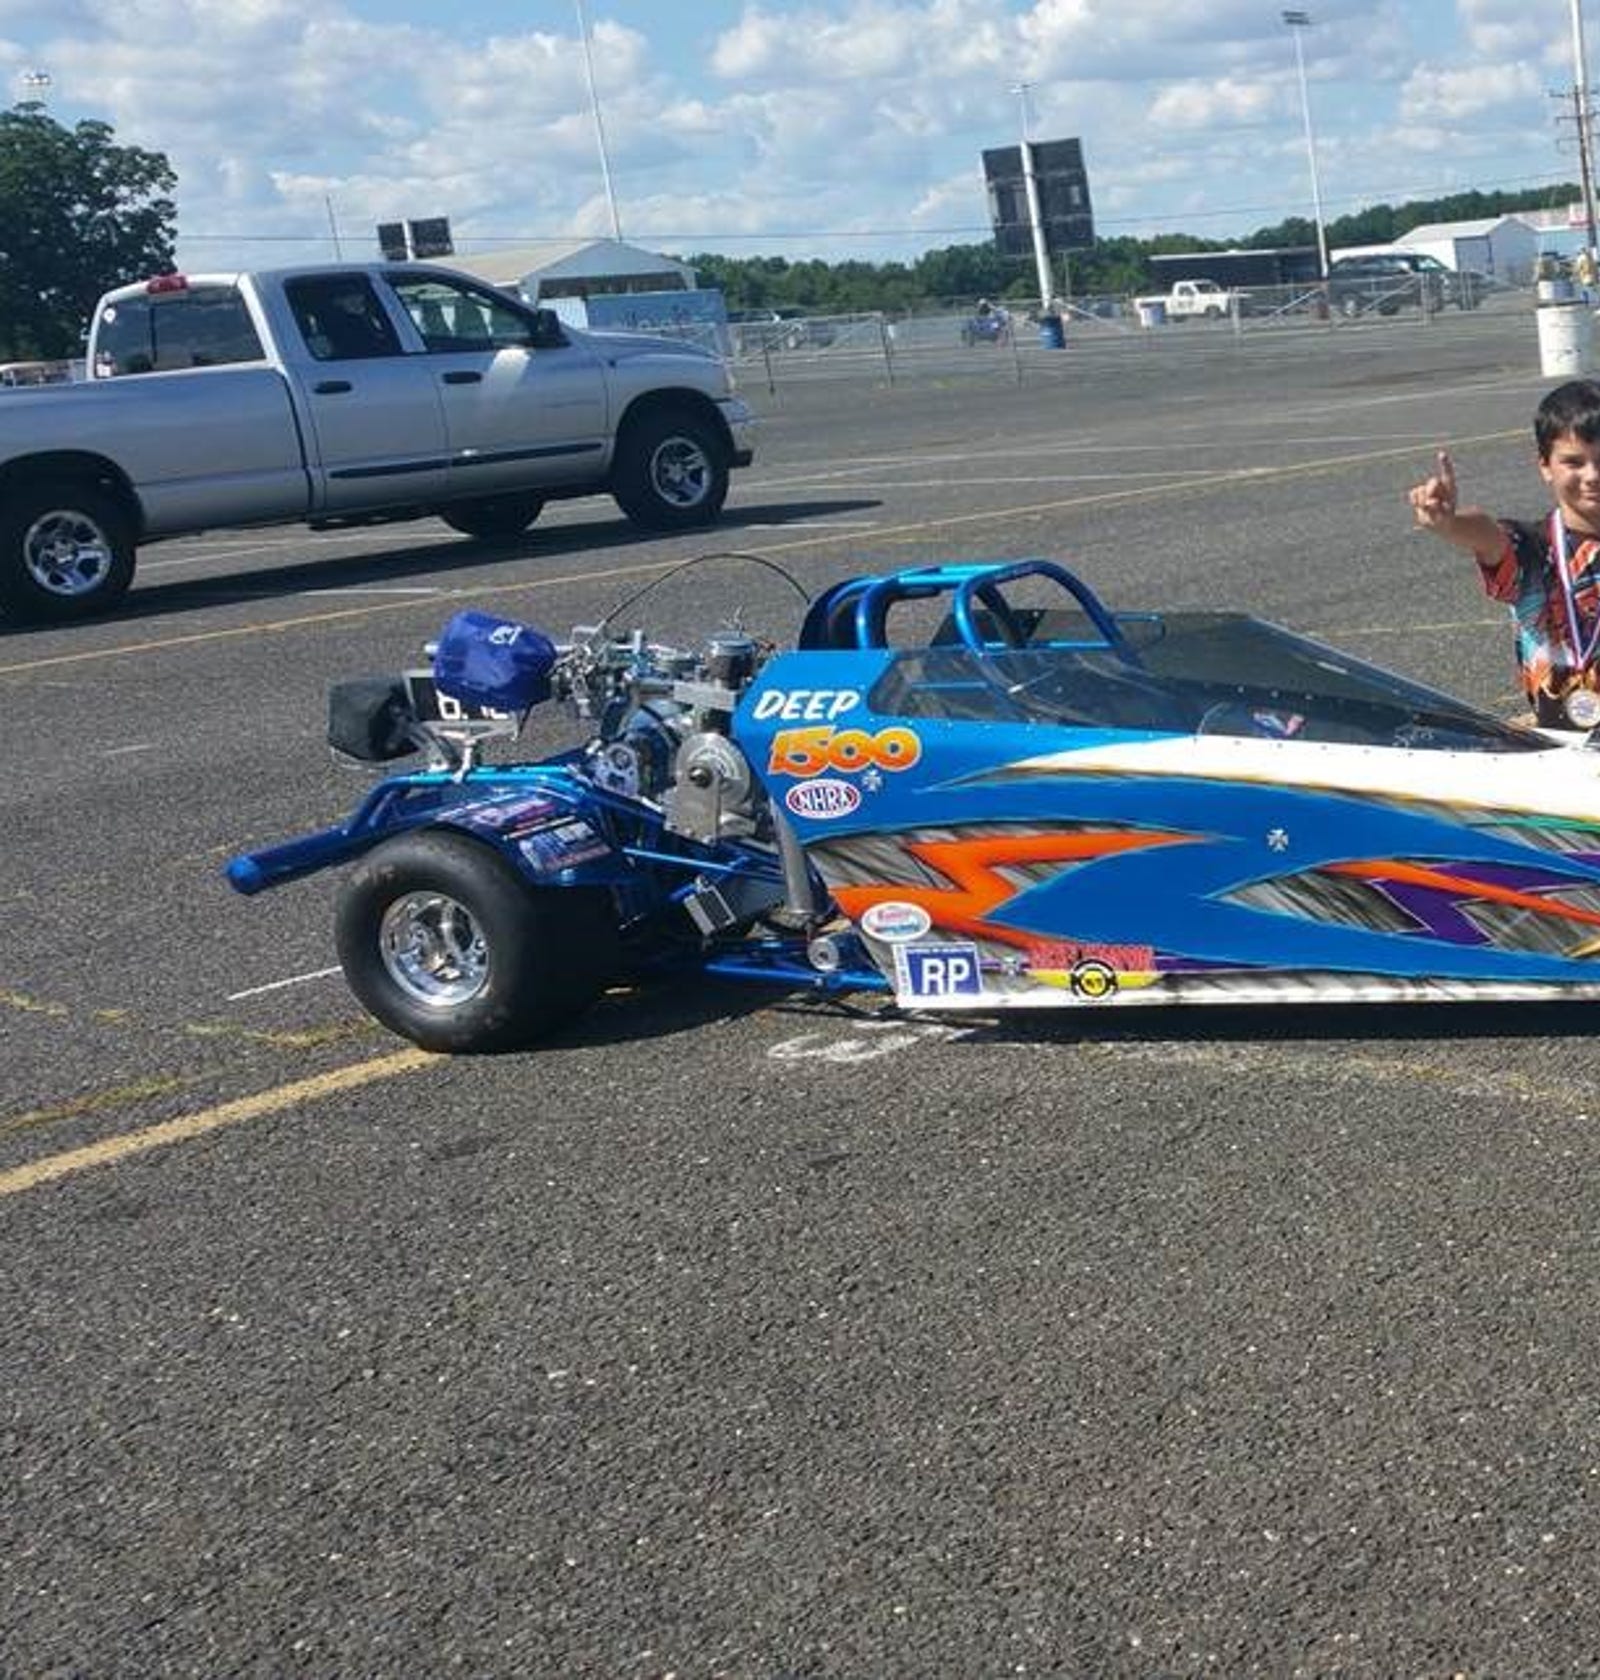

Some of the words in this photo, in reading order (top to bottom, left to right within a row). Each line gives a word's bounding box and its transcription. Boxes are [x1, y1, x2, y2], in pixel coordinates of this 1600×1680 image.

[753, 688, 861, 721] DEEP
[766, 725, 922, 778] 1500
[793, 784, 854, 813] NHRA
[921, 957, 971, 995] RP
